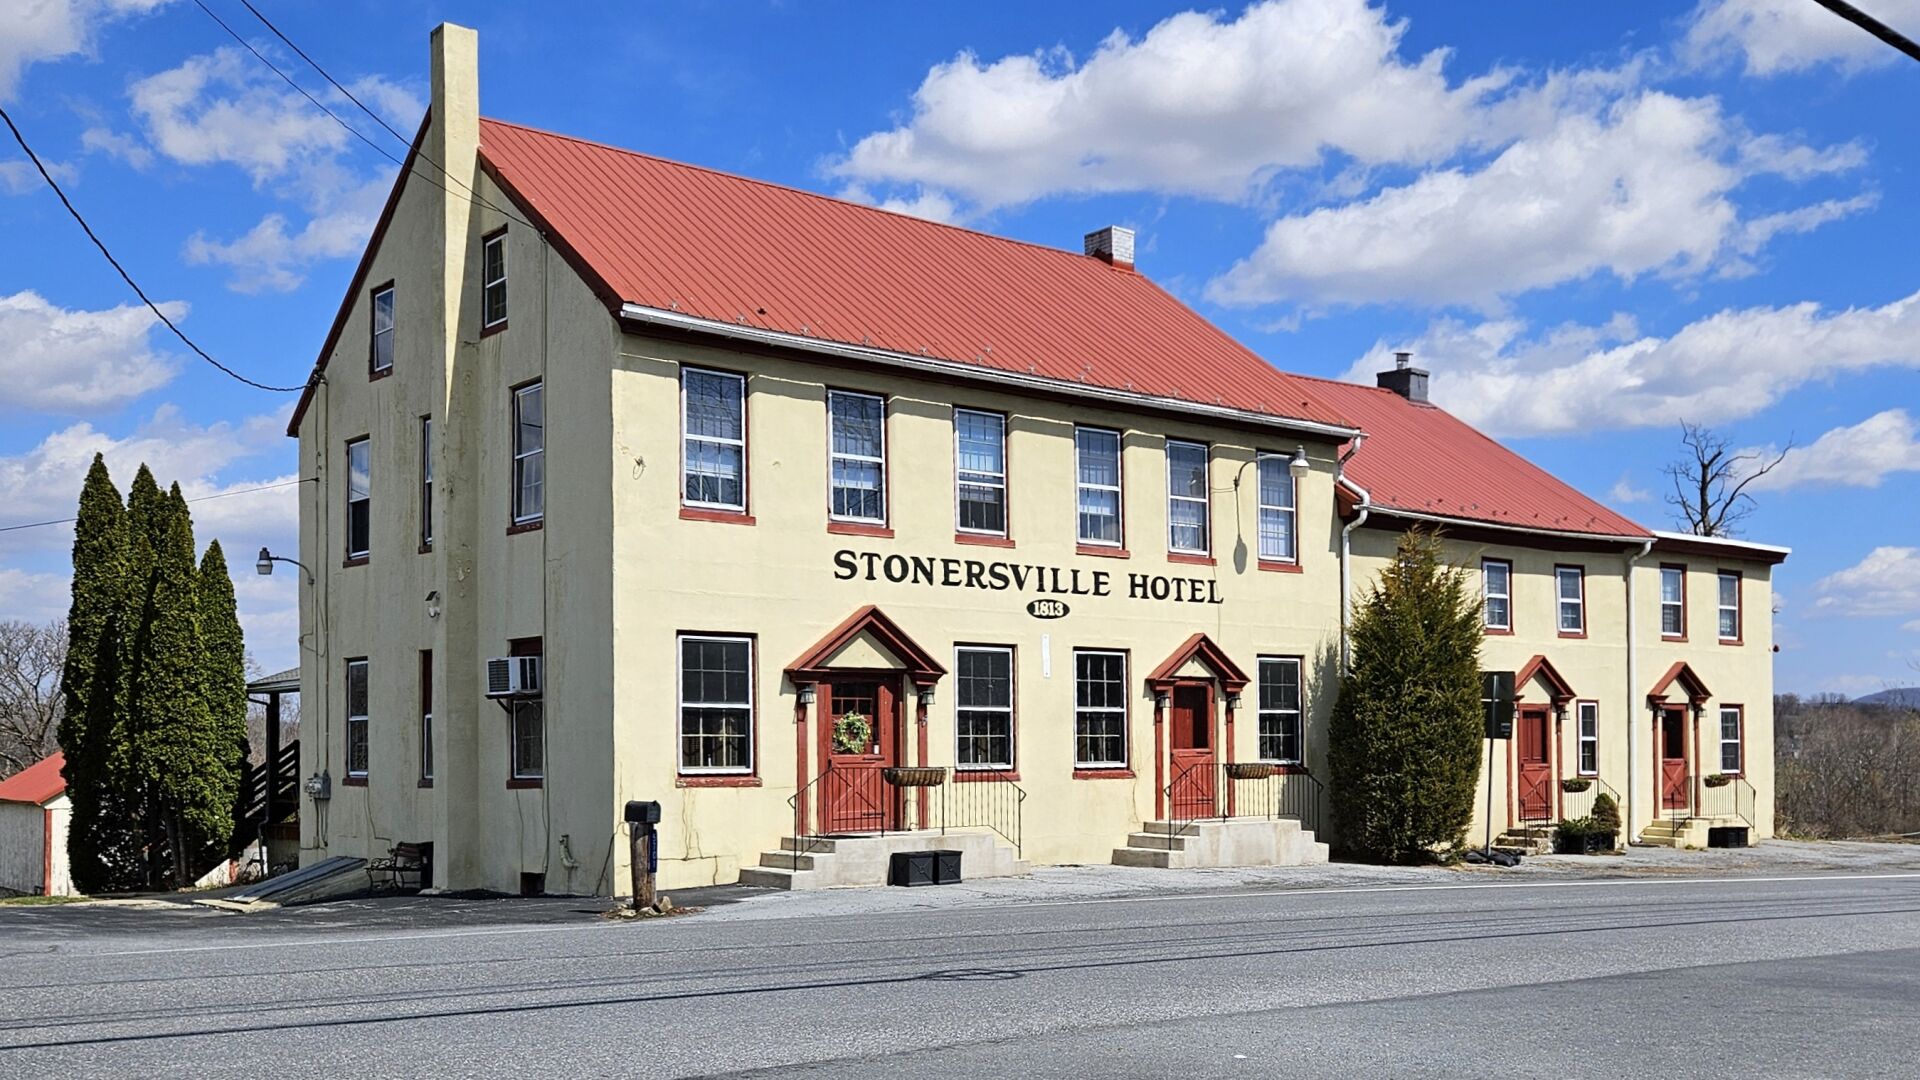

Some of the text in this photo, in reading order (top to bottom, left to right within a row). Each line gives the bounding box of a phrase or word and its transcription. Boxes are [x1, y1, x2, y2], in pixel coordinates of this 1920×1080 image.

[834, 549, 1223, 605] STONERSVILLE HOTEL
[1032, 600, 1065, 617] 1813
